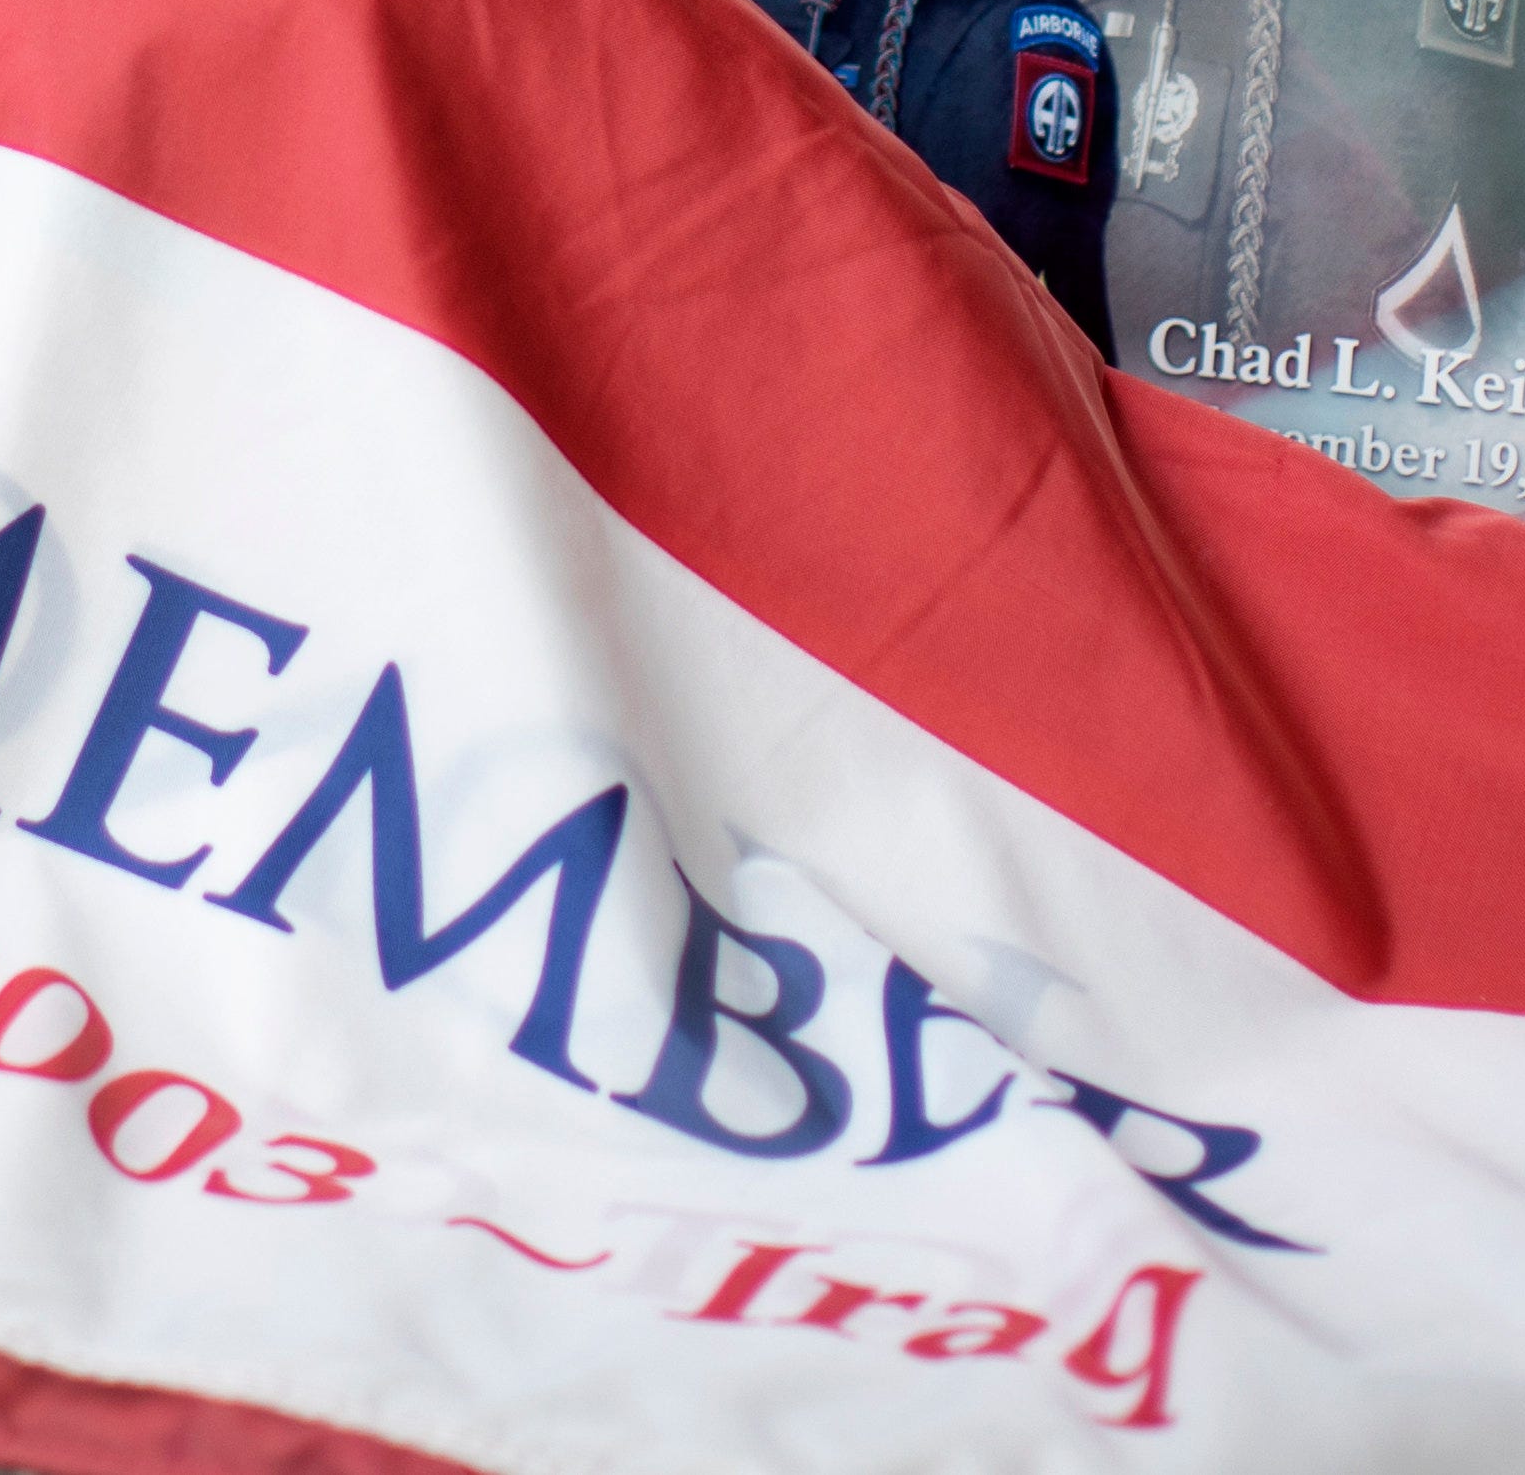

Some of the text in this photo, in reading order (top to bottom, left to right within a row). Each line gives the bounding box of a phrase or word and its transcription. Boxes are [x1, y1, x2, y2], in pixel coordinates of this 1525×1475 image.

[1018, 13, 1100, 59] AIRBORNE
[1148, 316, 1312, 391] Chad
[1329, 336, 1397, 401] L.
[662, 1239, 1206, 1432] Iraq
